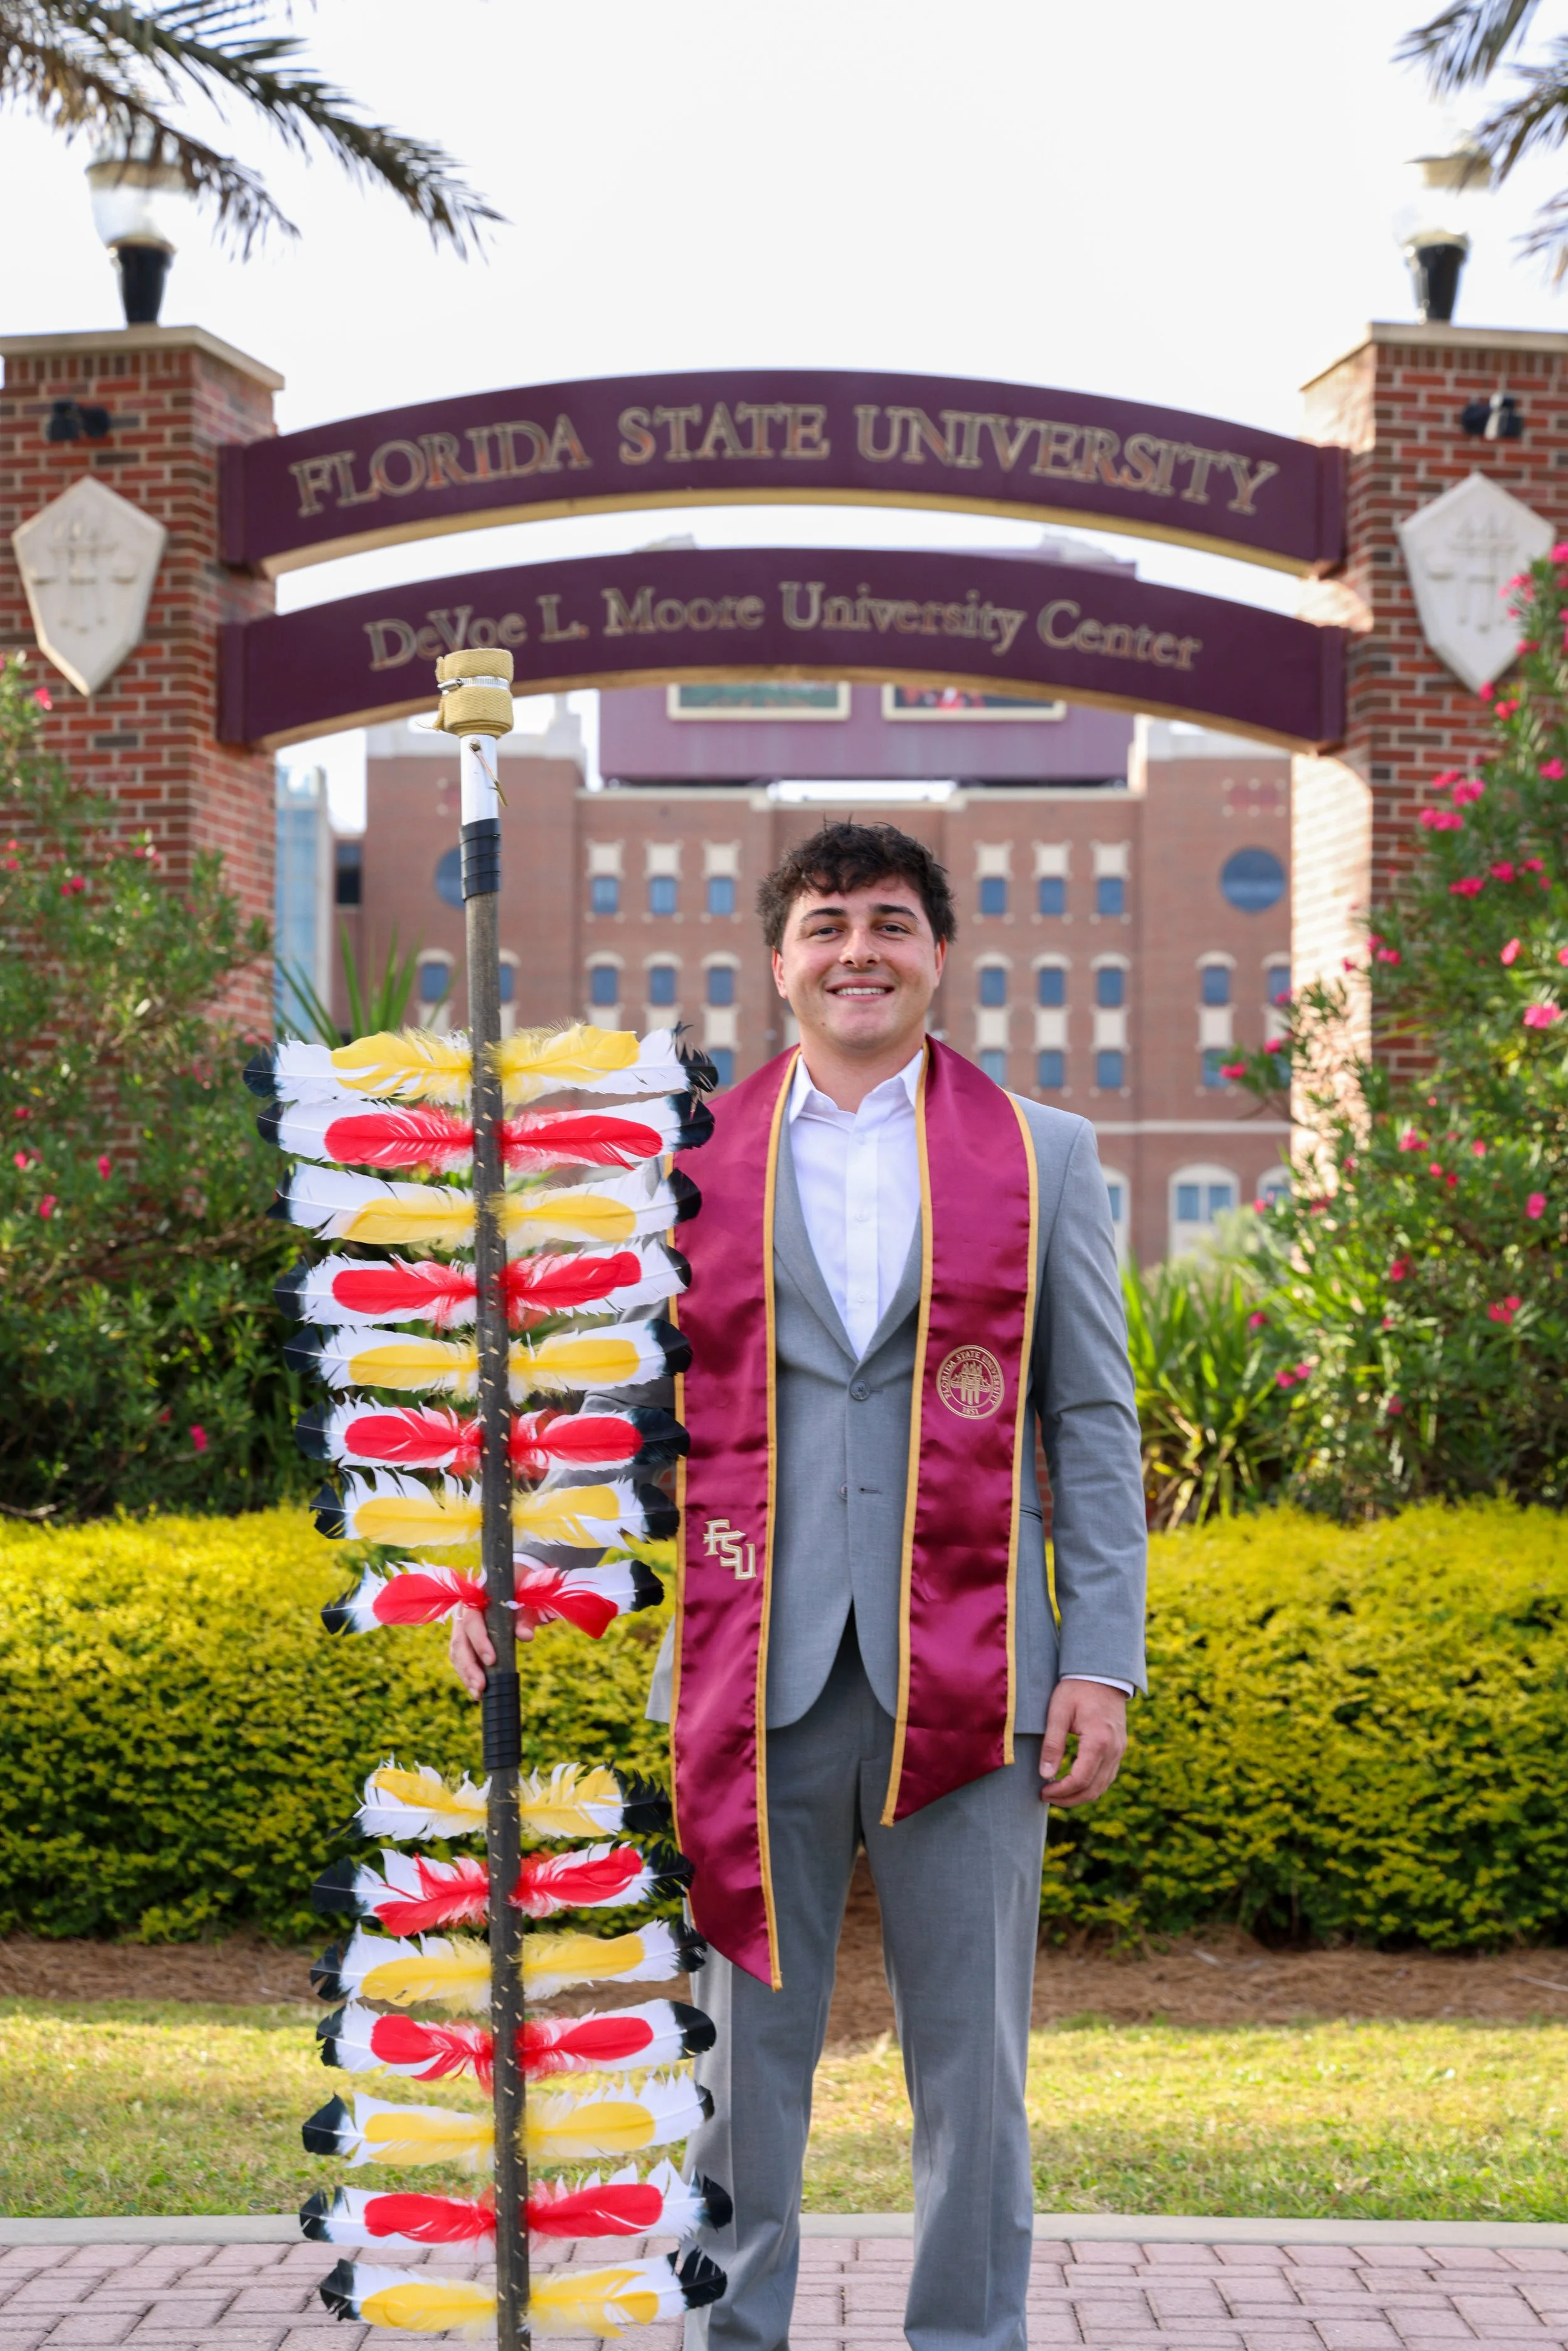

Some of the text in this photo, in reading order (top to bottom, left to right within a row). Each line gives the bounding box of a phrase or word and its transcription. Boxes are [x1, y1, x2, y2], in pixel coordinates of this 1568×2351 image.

[289, 401, 1279, 518] FLORIDA STATE UNIVERSITY
[363, 580, 1203, 671] DeVoe L. Moore University Center
[941, 1350, 1000, 1406] FLORIDA STATE UNIVERSITY
[702, 1519, 757, 1580] FSU
